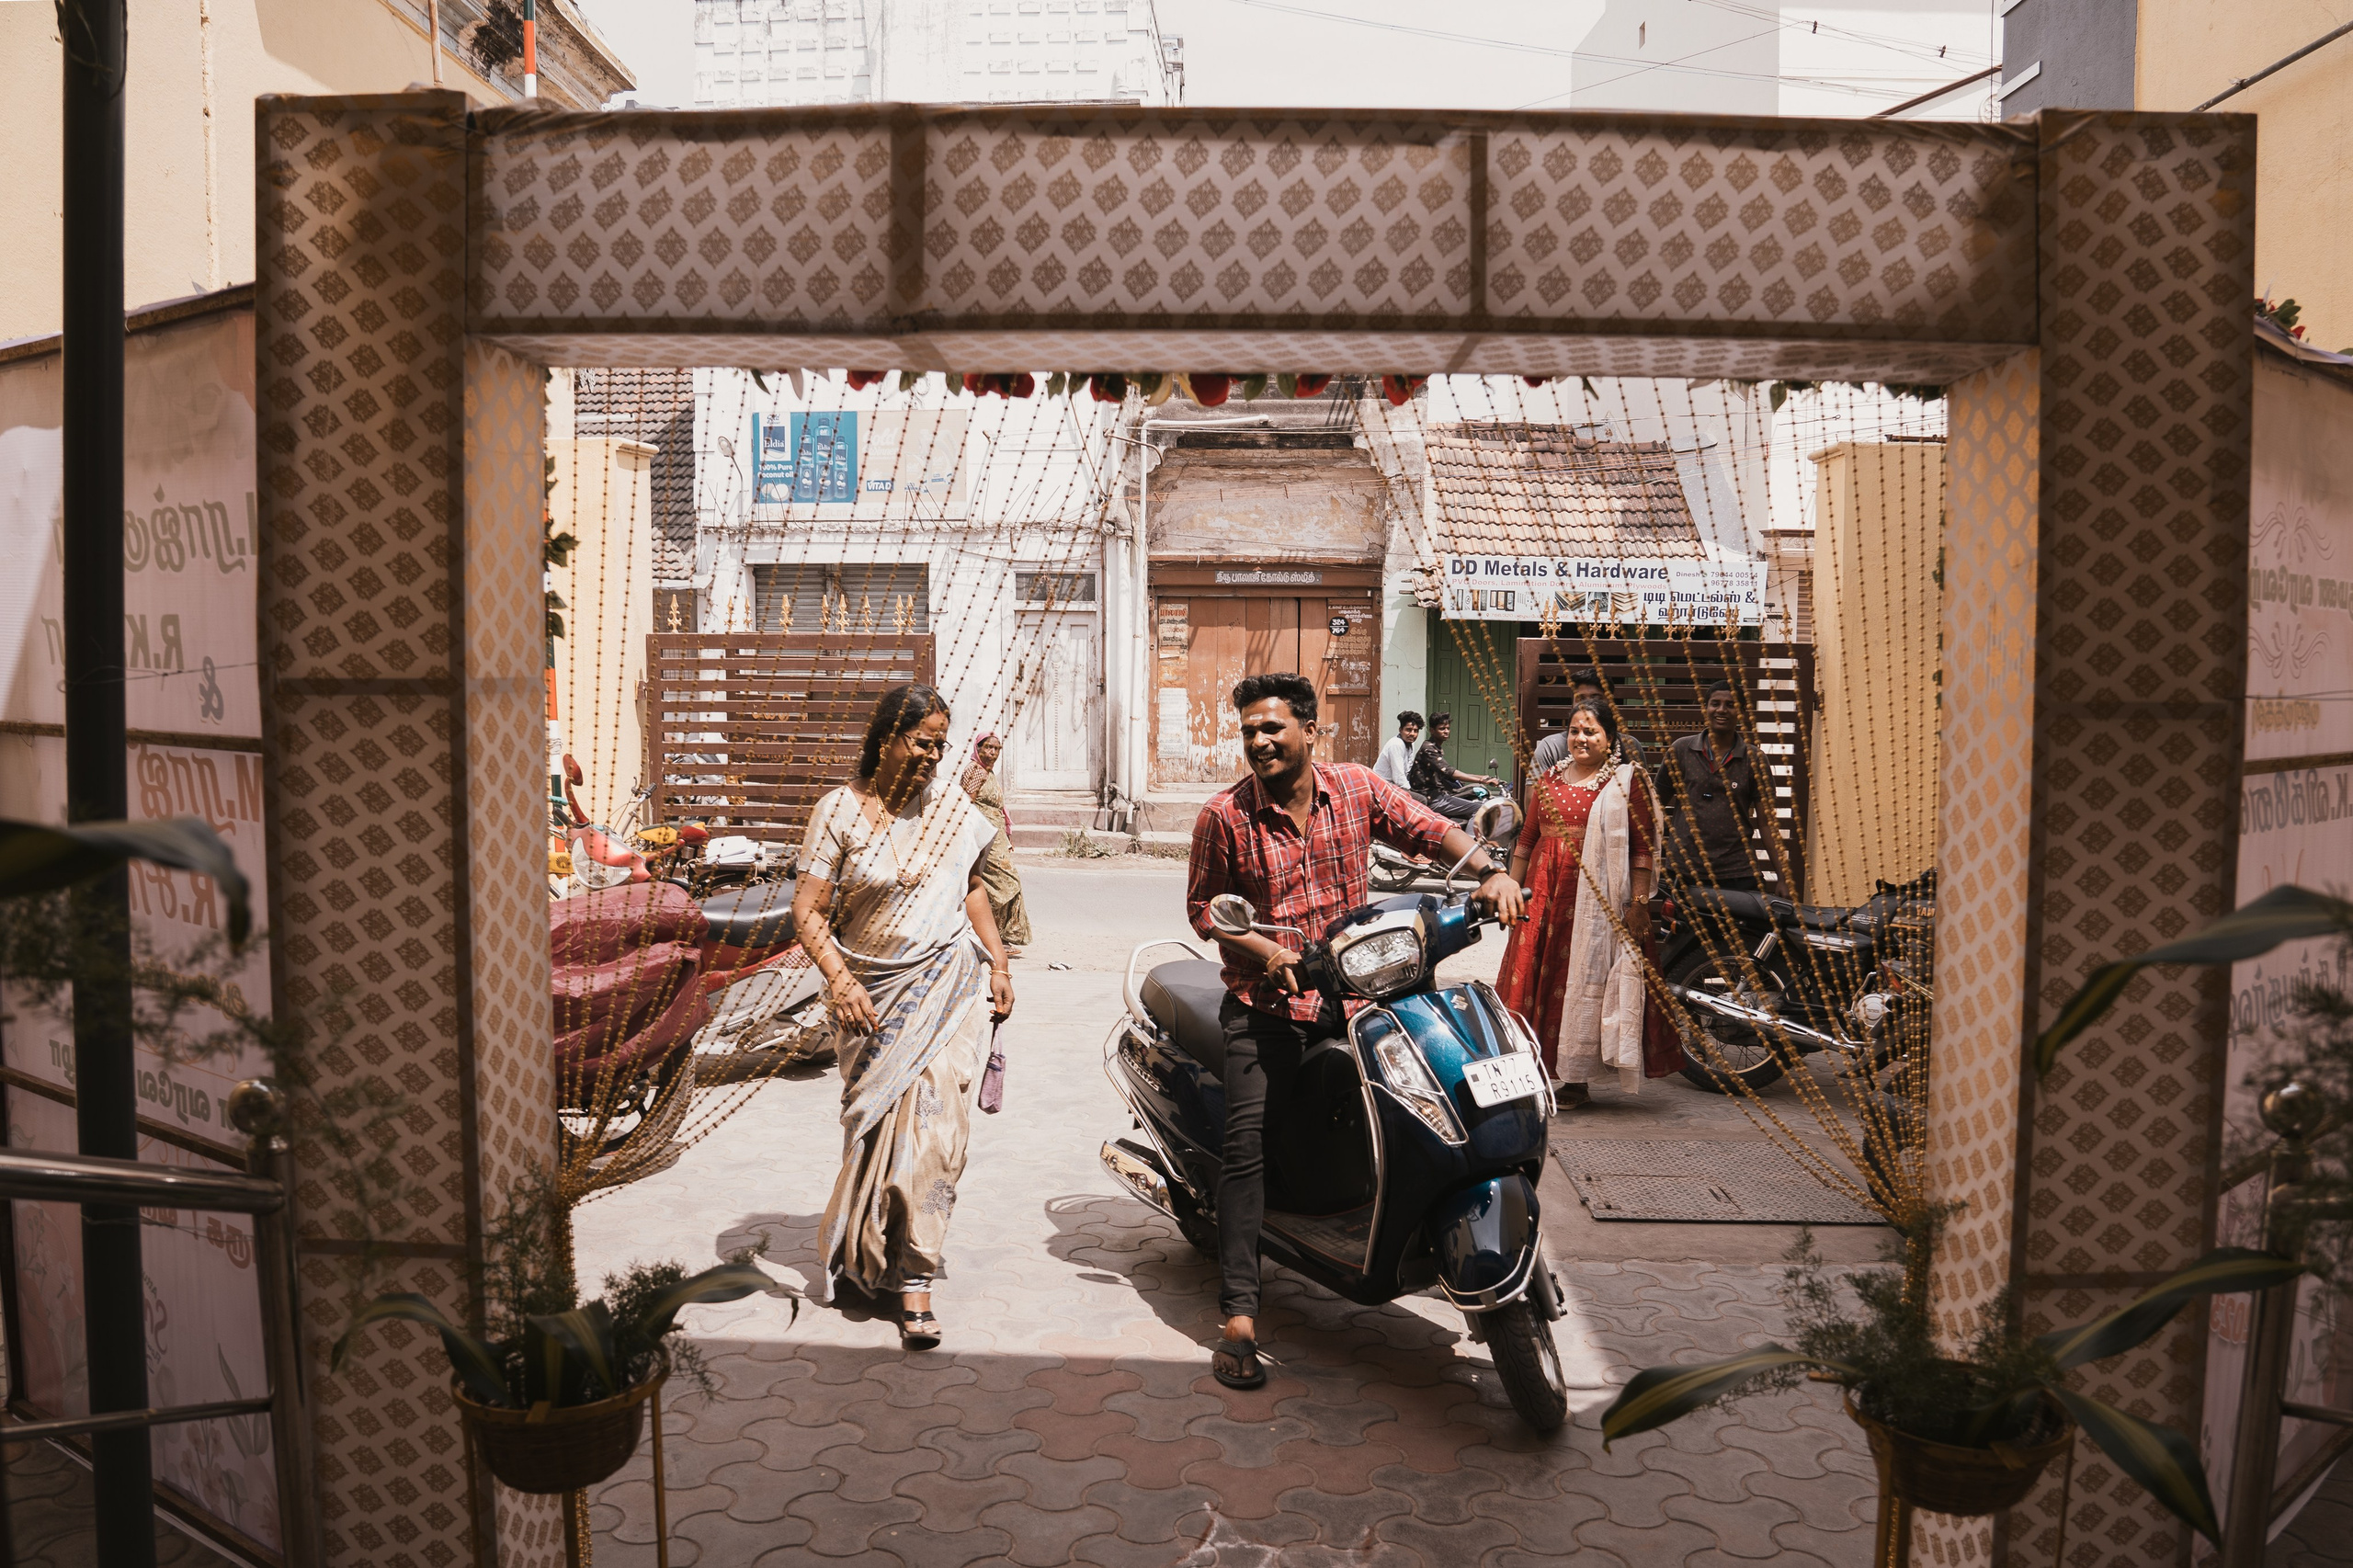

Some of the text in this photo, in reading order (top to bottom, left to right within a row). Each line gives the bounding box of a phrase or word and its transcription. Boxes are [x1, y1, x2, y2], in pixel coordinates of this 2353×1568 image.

[764, 438, 785, 448] Eldia
[1451, 559, 1668, 579] DD Metals & Hardware
[1626, 581, 1667, 589] Plywoods
[1643, 591, 1666, 605] டிடி
[1745, 591, 1756, 604] &
[1915, 906, 1936, 917] YAM
[1483, 1057, 1517, 1080] TN77
[1490, 1074, 1537, 1099] R9115
